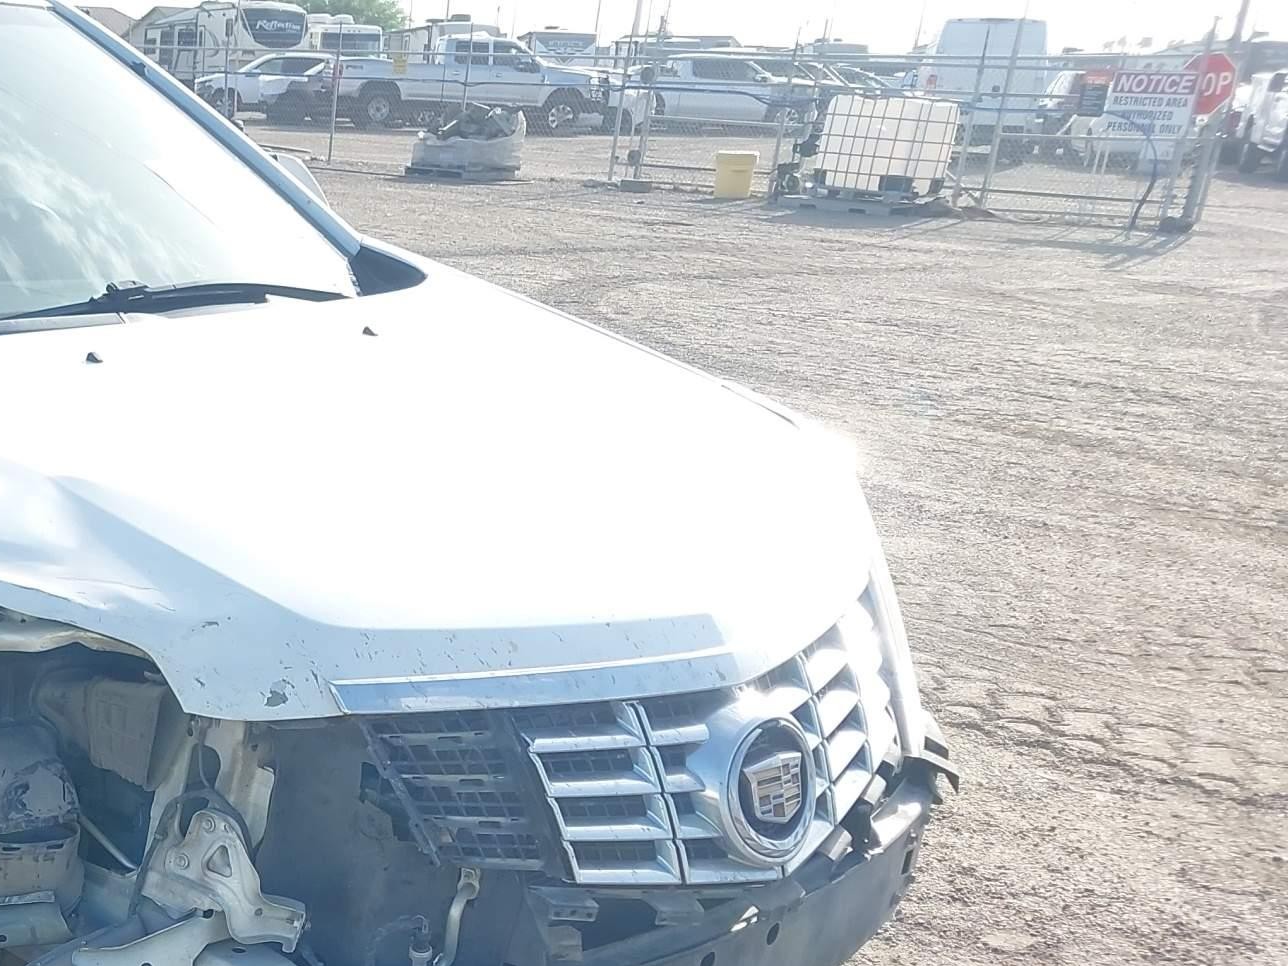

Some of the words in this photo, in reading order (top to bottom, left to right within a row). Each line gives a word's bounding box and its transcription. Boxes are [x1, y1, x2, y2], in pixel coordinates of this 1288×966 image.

[1116, 73, 1197, 93] NOTICE
[1202, 71, 1232, 97] OP
[1112, 96, 1164, 108] RESTRICTED
[1165, 97, 1188, 109] AREA
[1122, 110, 1174, 121] UTHORIZED
[1106, 121, 1156, 133] PERSOL
[1159, 123, 1184, 135] ONLY
